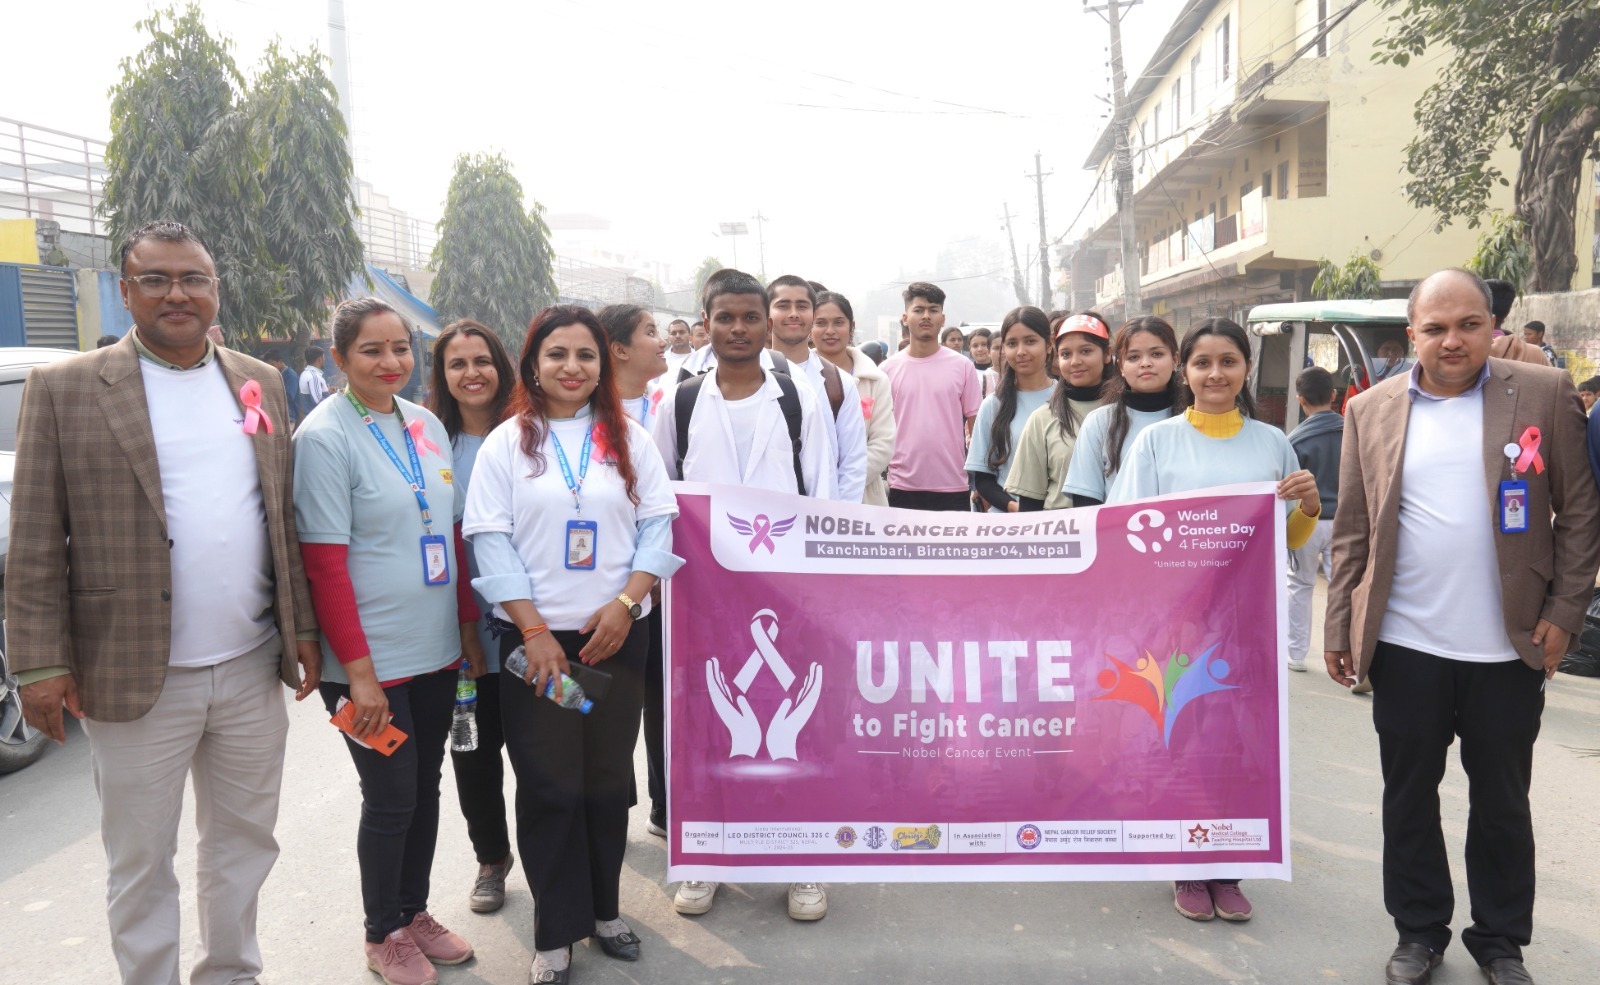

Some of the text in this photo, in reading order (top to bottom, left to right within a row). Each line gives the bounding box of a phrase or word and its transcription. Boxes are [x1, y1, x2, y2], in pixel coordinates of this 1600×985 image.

[1177, 509, 1218, 522] World
[805, 515, 1080, 537] NOBEL CANCER HOSPITAL
[1178, 523, 1256, 537] Cancer Day
[817, 543, 1069, 559] Kanchanbari, Biratnagar-04, Nepal
[1179, 538, 1248, 551] 4 February
[1187, 560, 1198, 569] by
[856, 640, 1075, 704] UNITE
[853, 710, 1076, 744] to Fight Cancer
[902, 747, 1032, 758] Nobel Cancer Event
[1211, 823, 1233, 831] Nobel
[684, 831, 719, 839] Organized
[1128, 832, 1176, 840] Supported by:
